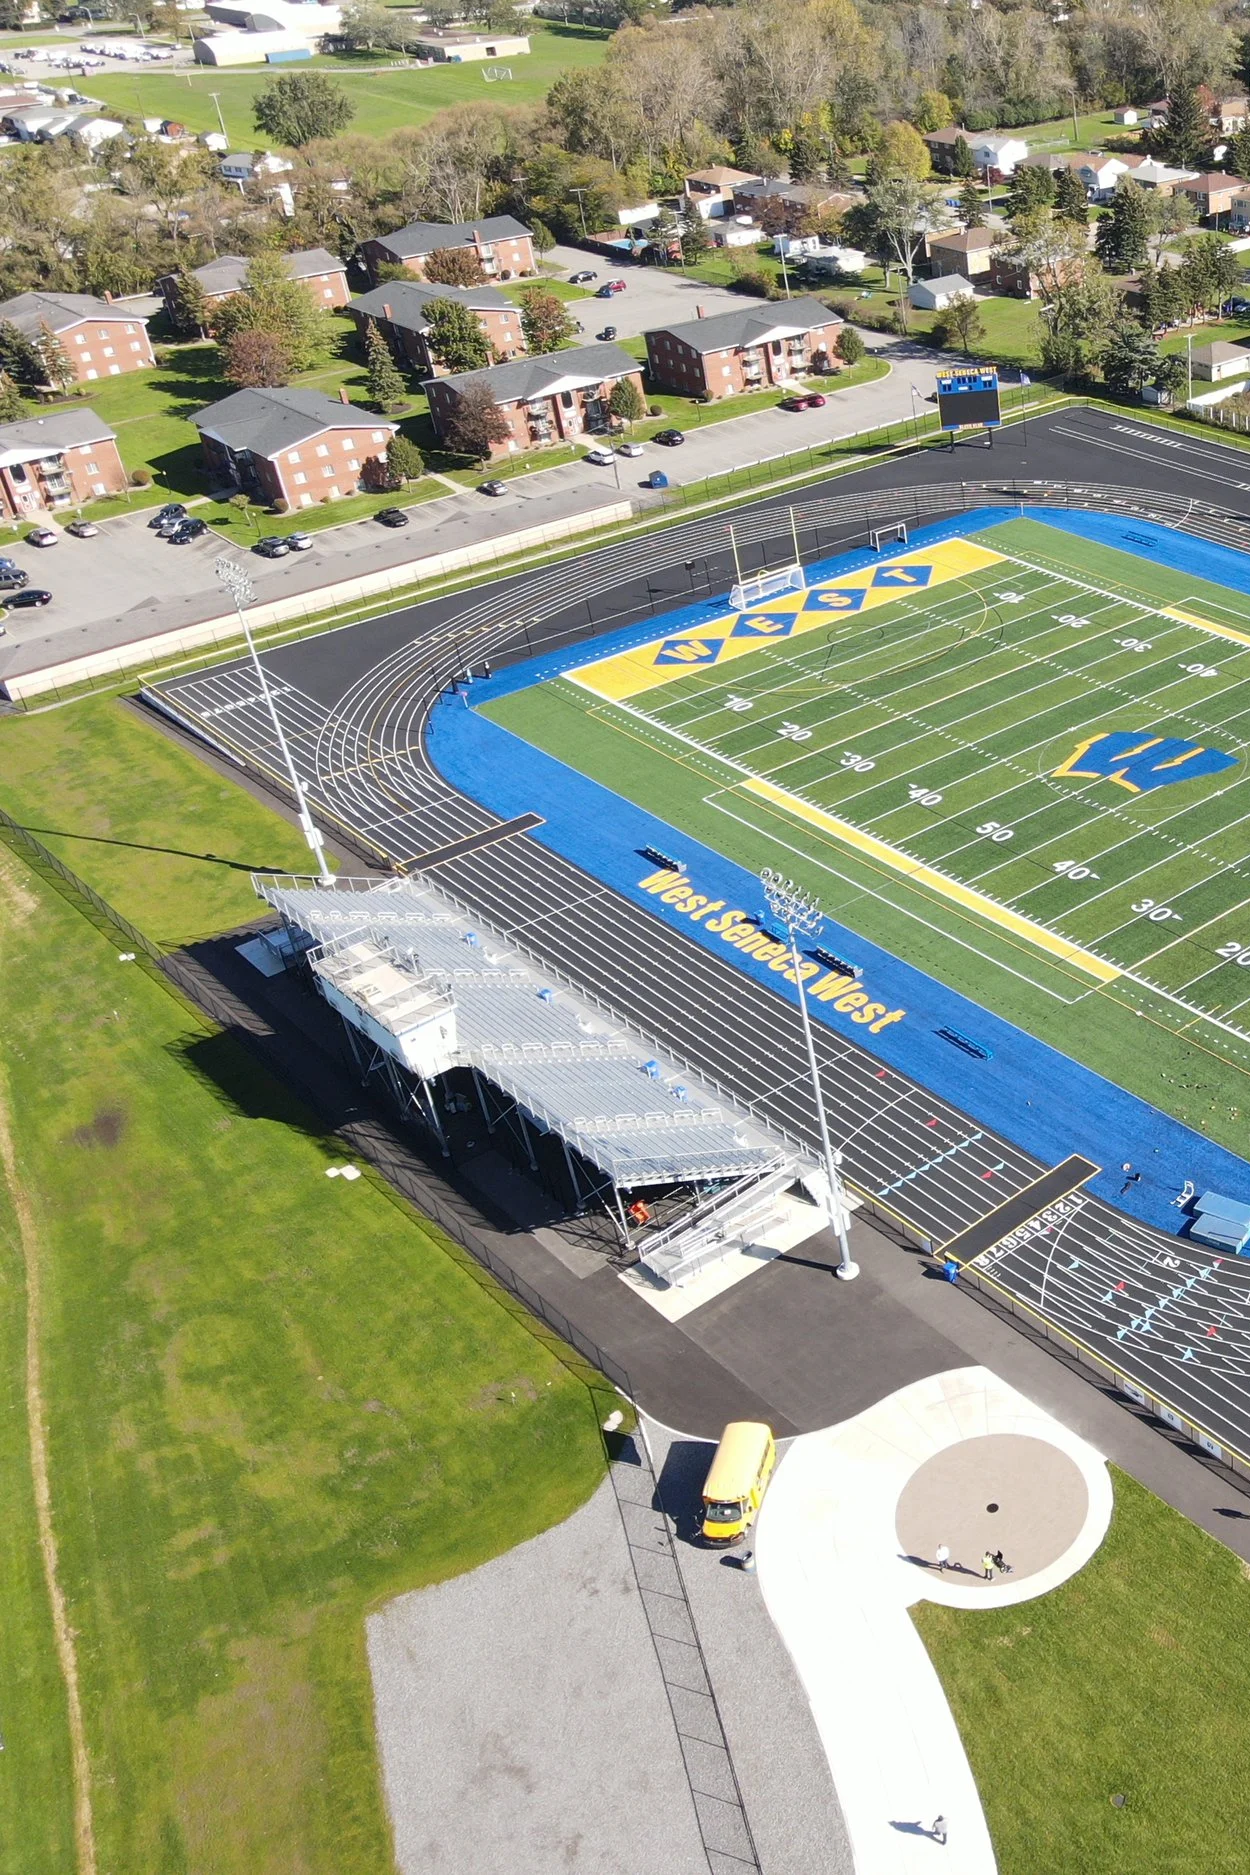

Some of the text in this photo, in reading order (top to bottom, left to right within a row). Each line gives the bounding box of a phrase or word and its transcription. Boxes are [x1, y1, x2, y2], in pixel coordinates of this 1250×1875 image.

[979, 366, 997, 375] WEST
[999, 591, 1026, 604] 10
[1057, 614, 1091, 628] 20
[1120, 637, 1153, 653] 30
[1186, 663, 1219, 678] 40
[729, 695, 753, 712] 10
[776, 723, 813, 742] 20
[840, 754, 876, 773] 30
[908, 787, 944, 807] 40
[975, 821, 1015, 843] 50
[1051, 858, 1091, 881] 40
[1130, 898, 1173, 922] 30
[637, 868, 907, 1034] West Seneca West
[1067, 1194, 1083, 1205] 1
[1054, 1201, 1072, 1214] 2
[1041, 1210, 1058, 1222] 3
[1026, 1219, 1042, 1231] 4
[1015, 1227, 1032, 1240] 5
[1001, 1237, 1019, 1249] 6
[989, 1247, 1005, 1258] 7
[1163, 1256, 1181, 1268] 2
